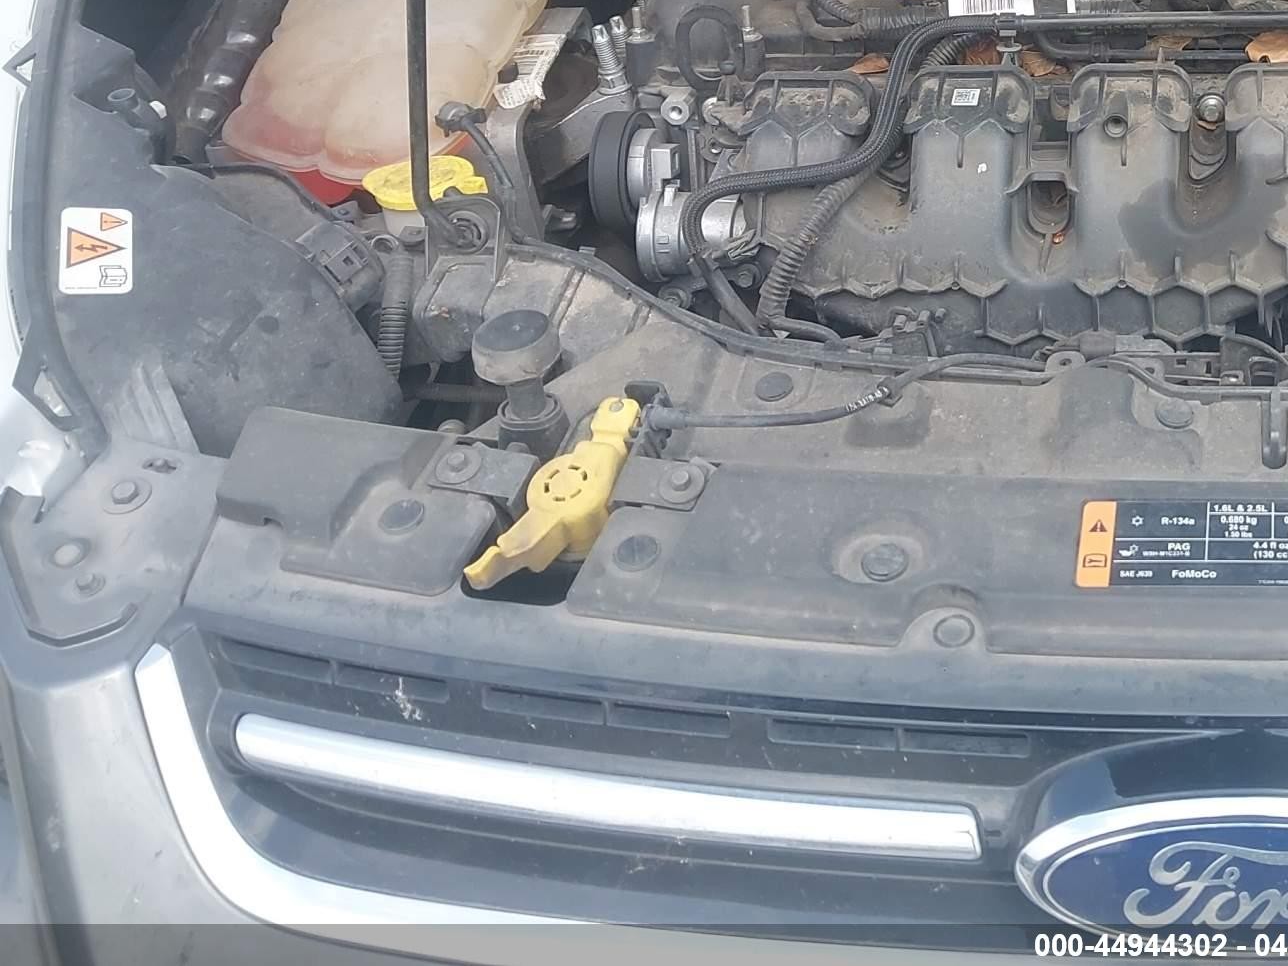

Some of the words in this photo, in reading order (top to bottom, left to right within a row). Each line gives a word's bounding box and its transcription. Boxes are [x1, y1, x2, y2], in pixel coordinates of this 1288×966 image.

[1213, 504, 1235, 512] 1.6L
[1246, 504, 1269, 512] 2.5L
[1160, 516, 1195, 525] R-134a
[1245, 515, 1258, 525] kg
[1167, 542, 1191, 551] PAG
[1252, 541, 1268, 549] 4.4
[1253, 550, 1275, 560] (130
[1171, 569, 1217, 579] FoMoCo
